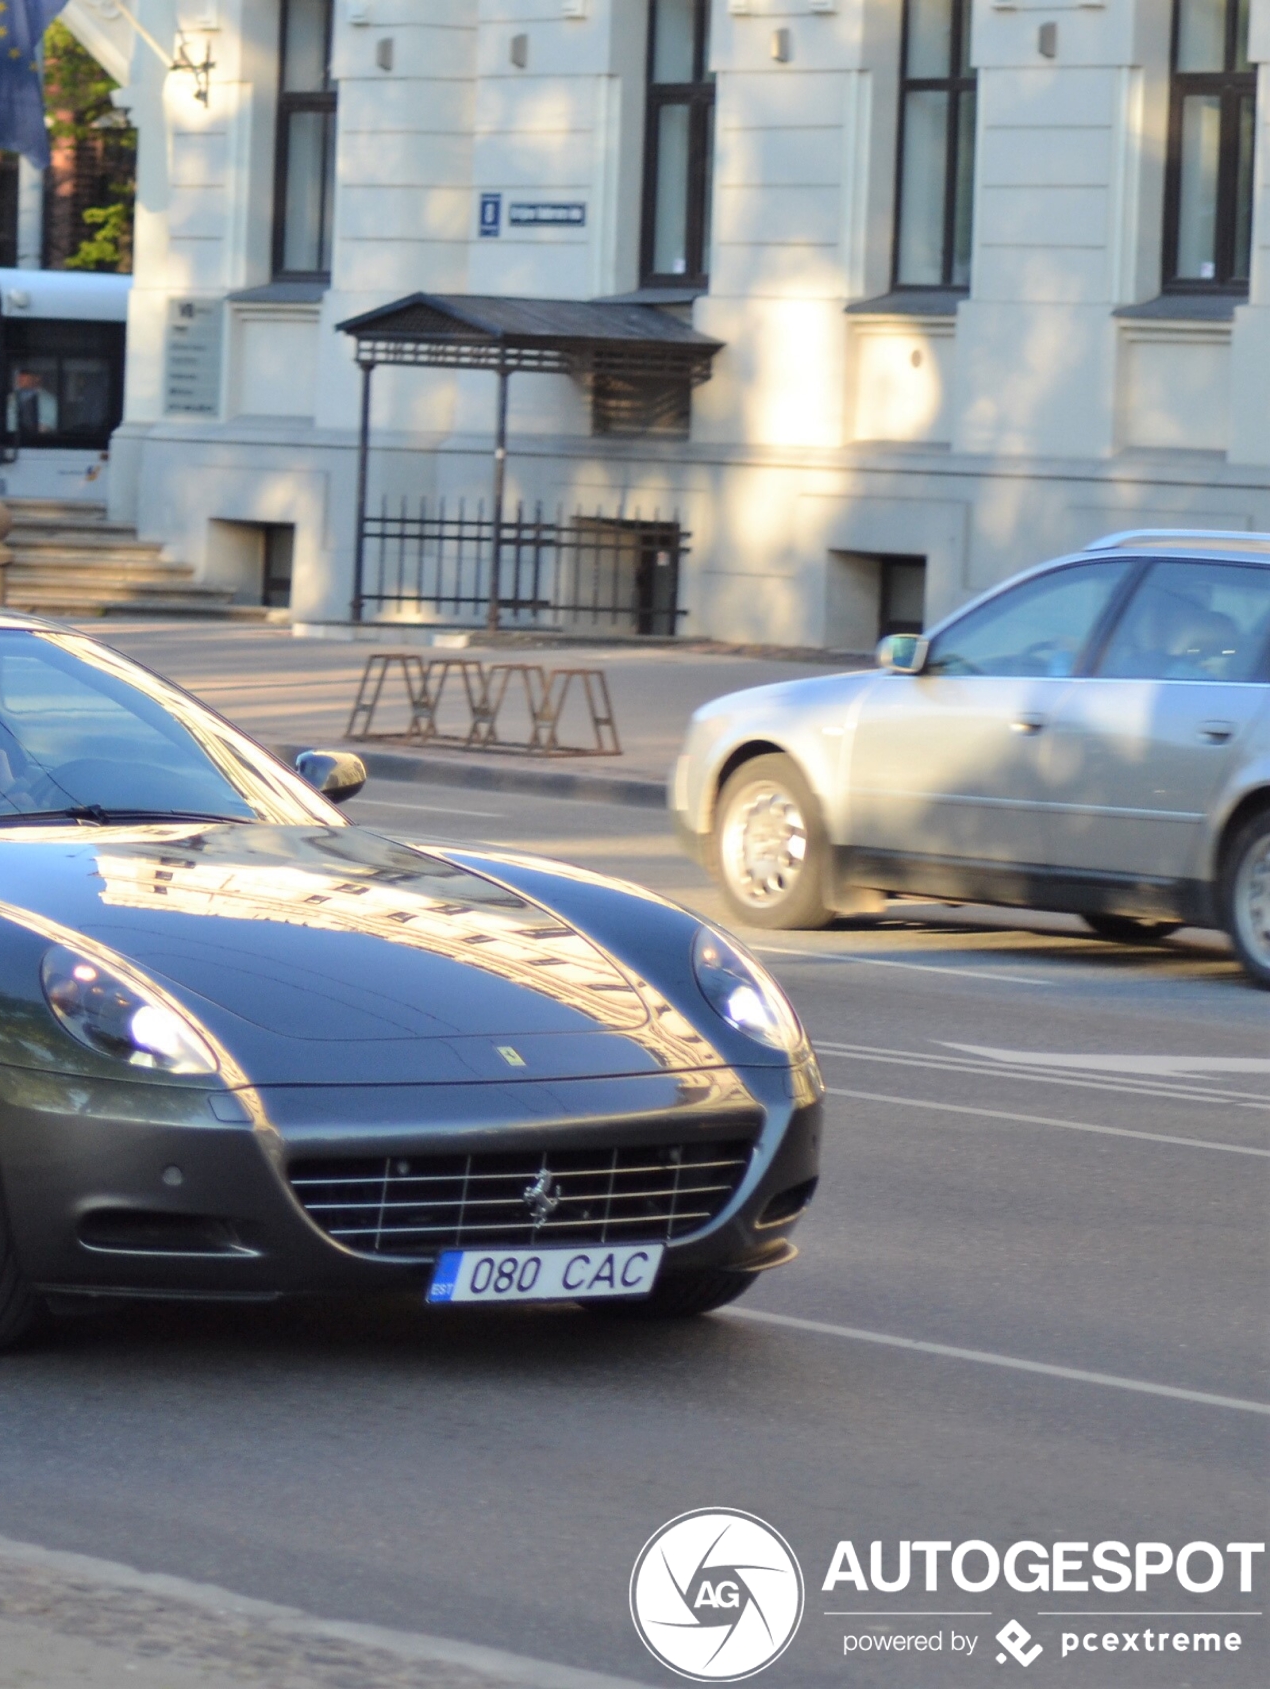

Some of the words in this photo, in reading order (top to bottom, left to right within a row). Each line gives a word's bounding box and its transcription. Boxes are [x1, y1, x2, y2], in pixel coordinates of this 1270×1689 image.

[469, 1256, 543, 1295] 080
[560, 1250, 650, 1291] CAC
[431, 1282, 454, 1297] EST
